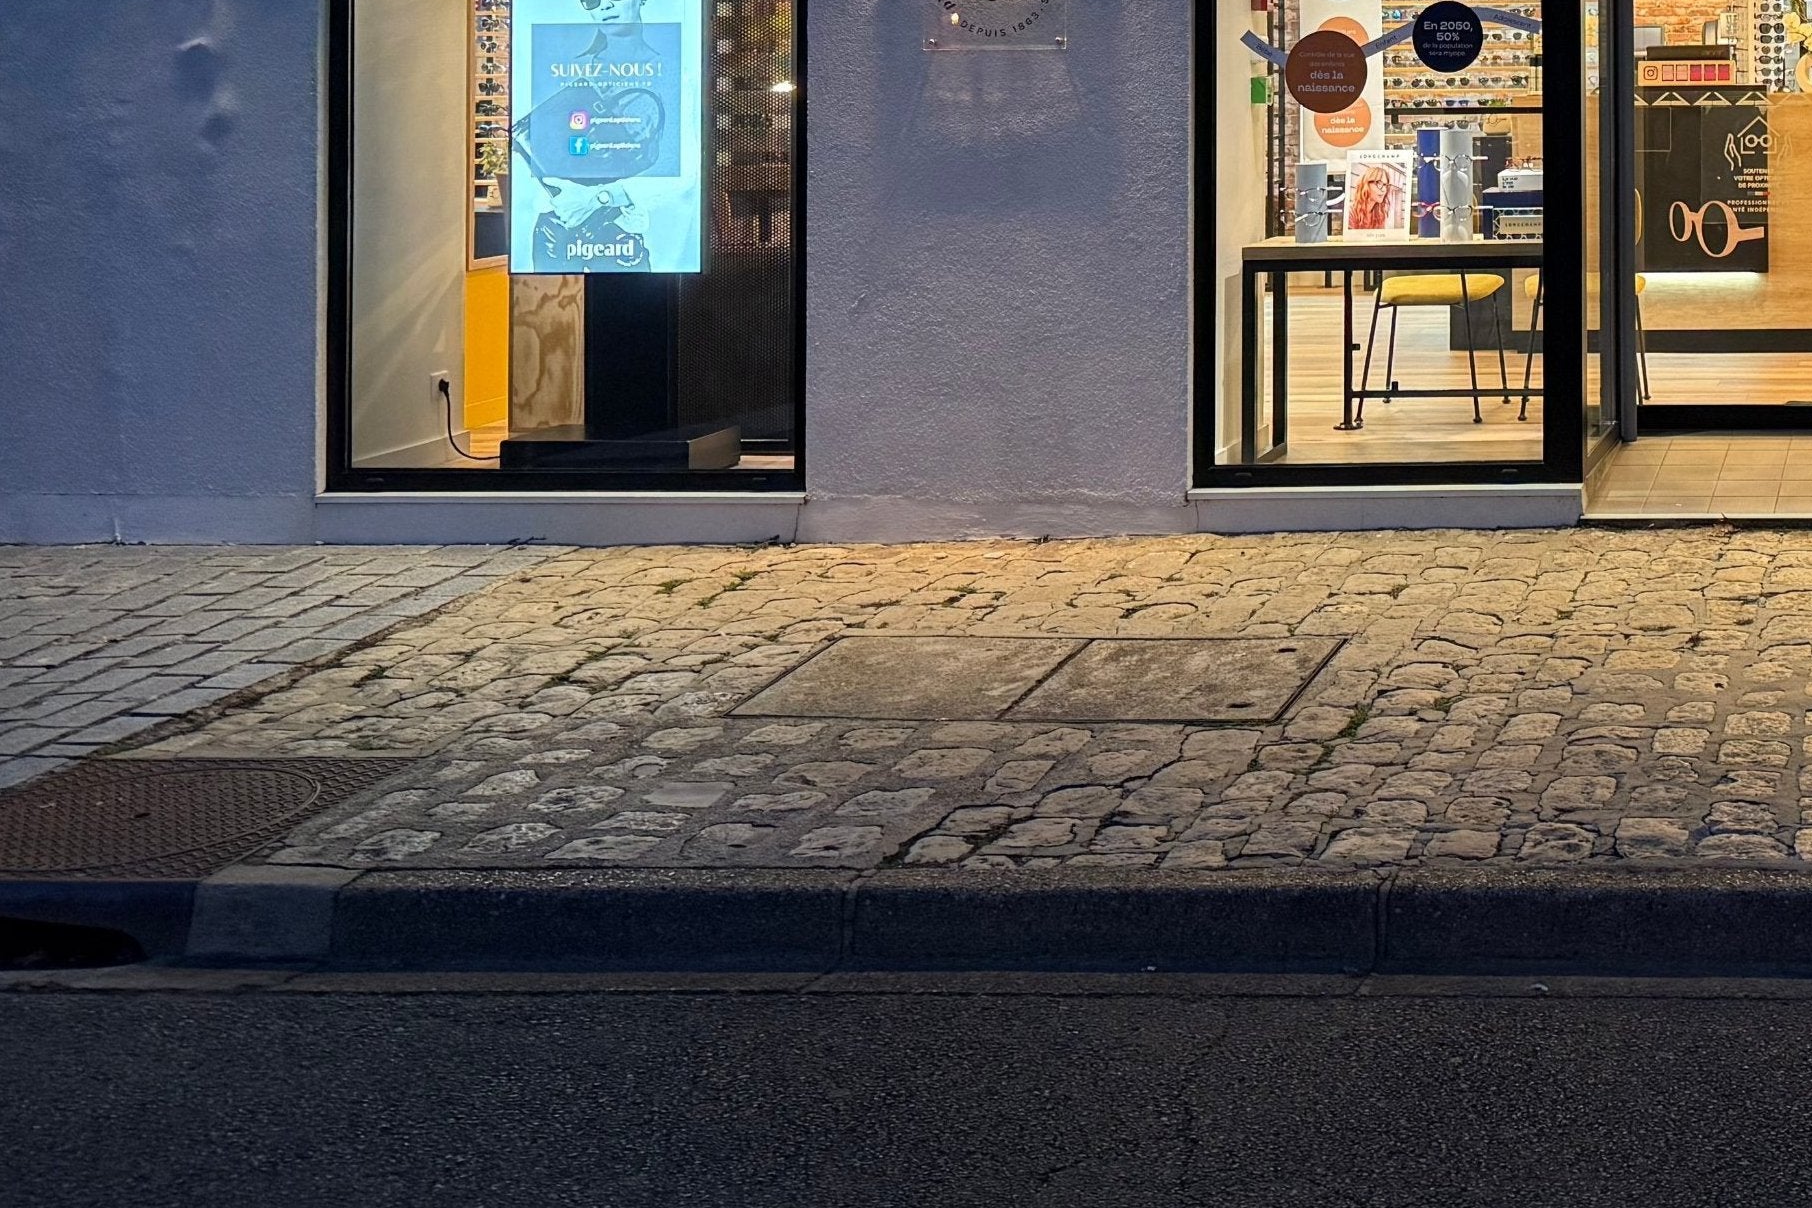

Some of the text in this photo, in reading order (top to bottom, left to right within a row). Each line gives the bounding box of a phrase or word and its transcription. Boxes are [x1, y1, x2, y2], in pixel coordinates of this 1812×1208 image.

[960, 20, 1007, 37] DEPUIS
[1424, 21, 1474, 32] En 2050,
[1436, 32, 1460, 42] 50%
[550, 63, 654, 77] SUIVEZ-NOUS
[1310, 69, 1344, 79] dès la
[1298, 82, 1355, 92] naissance
[566, 239, 634, 260] pigeard
